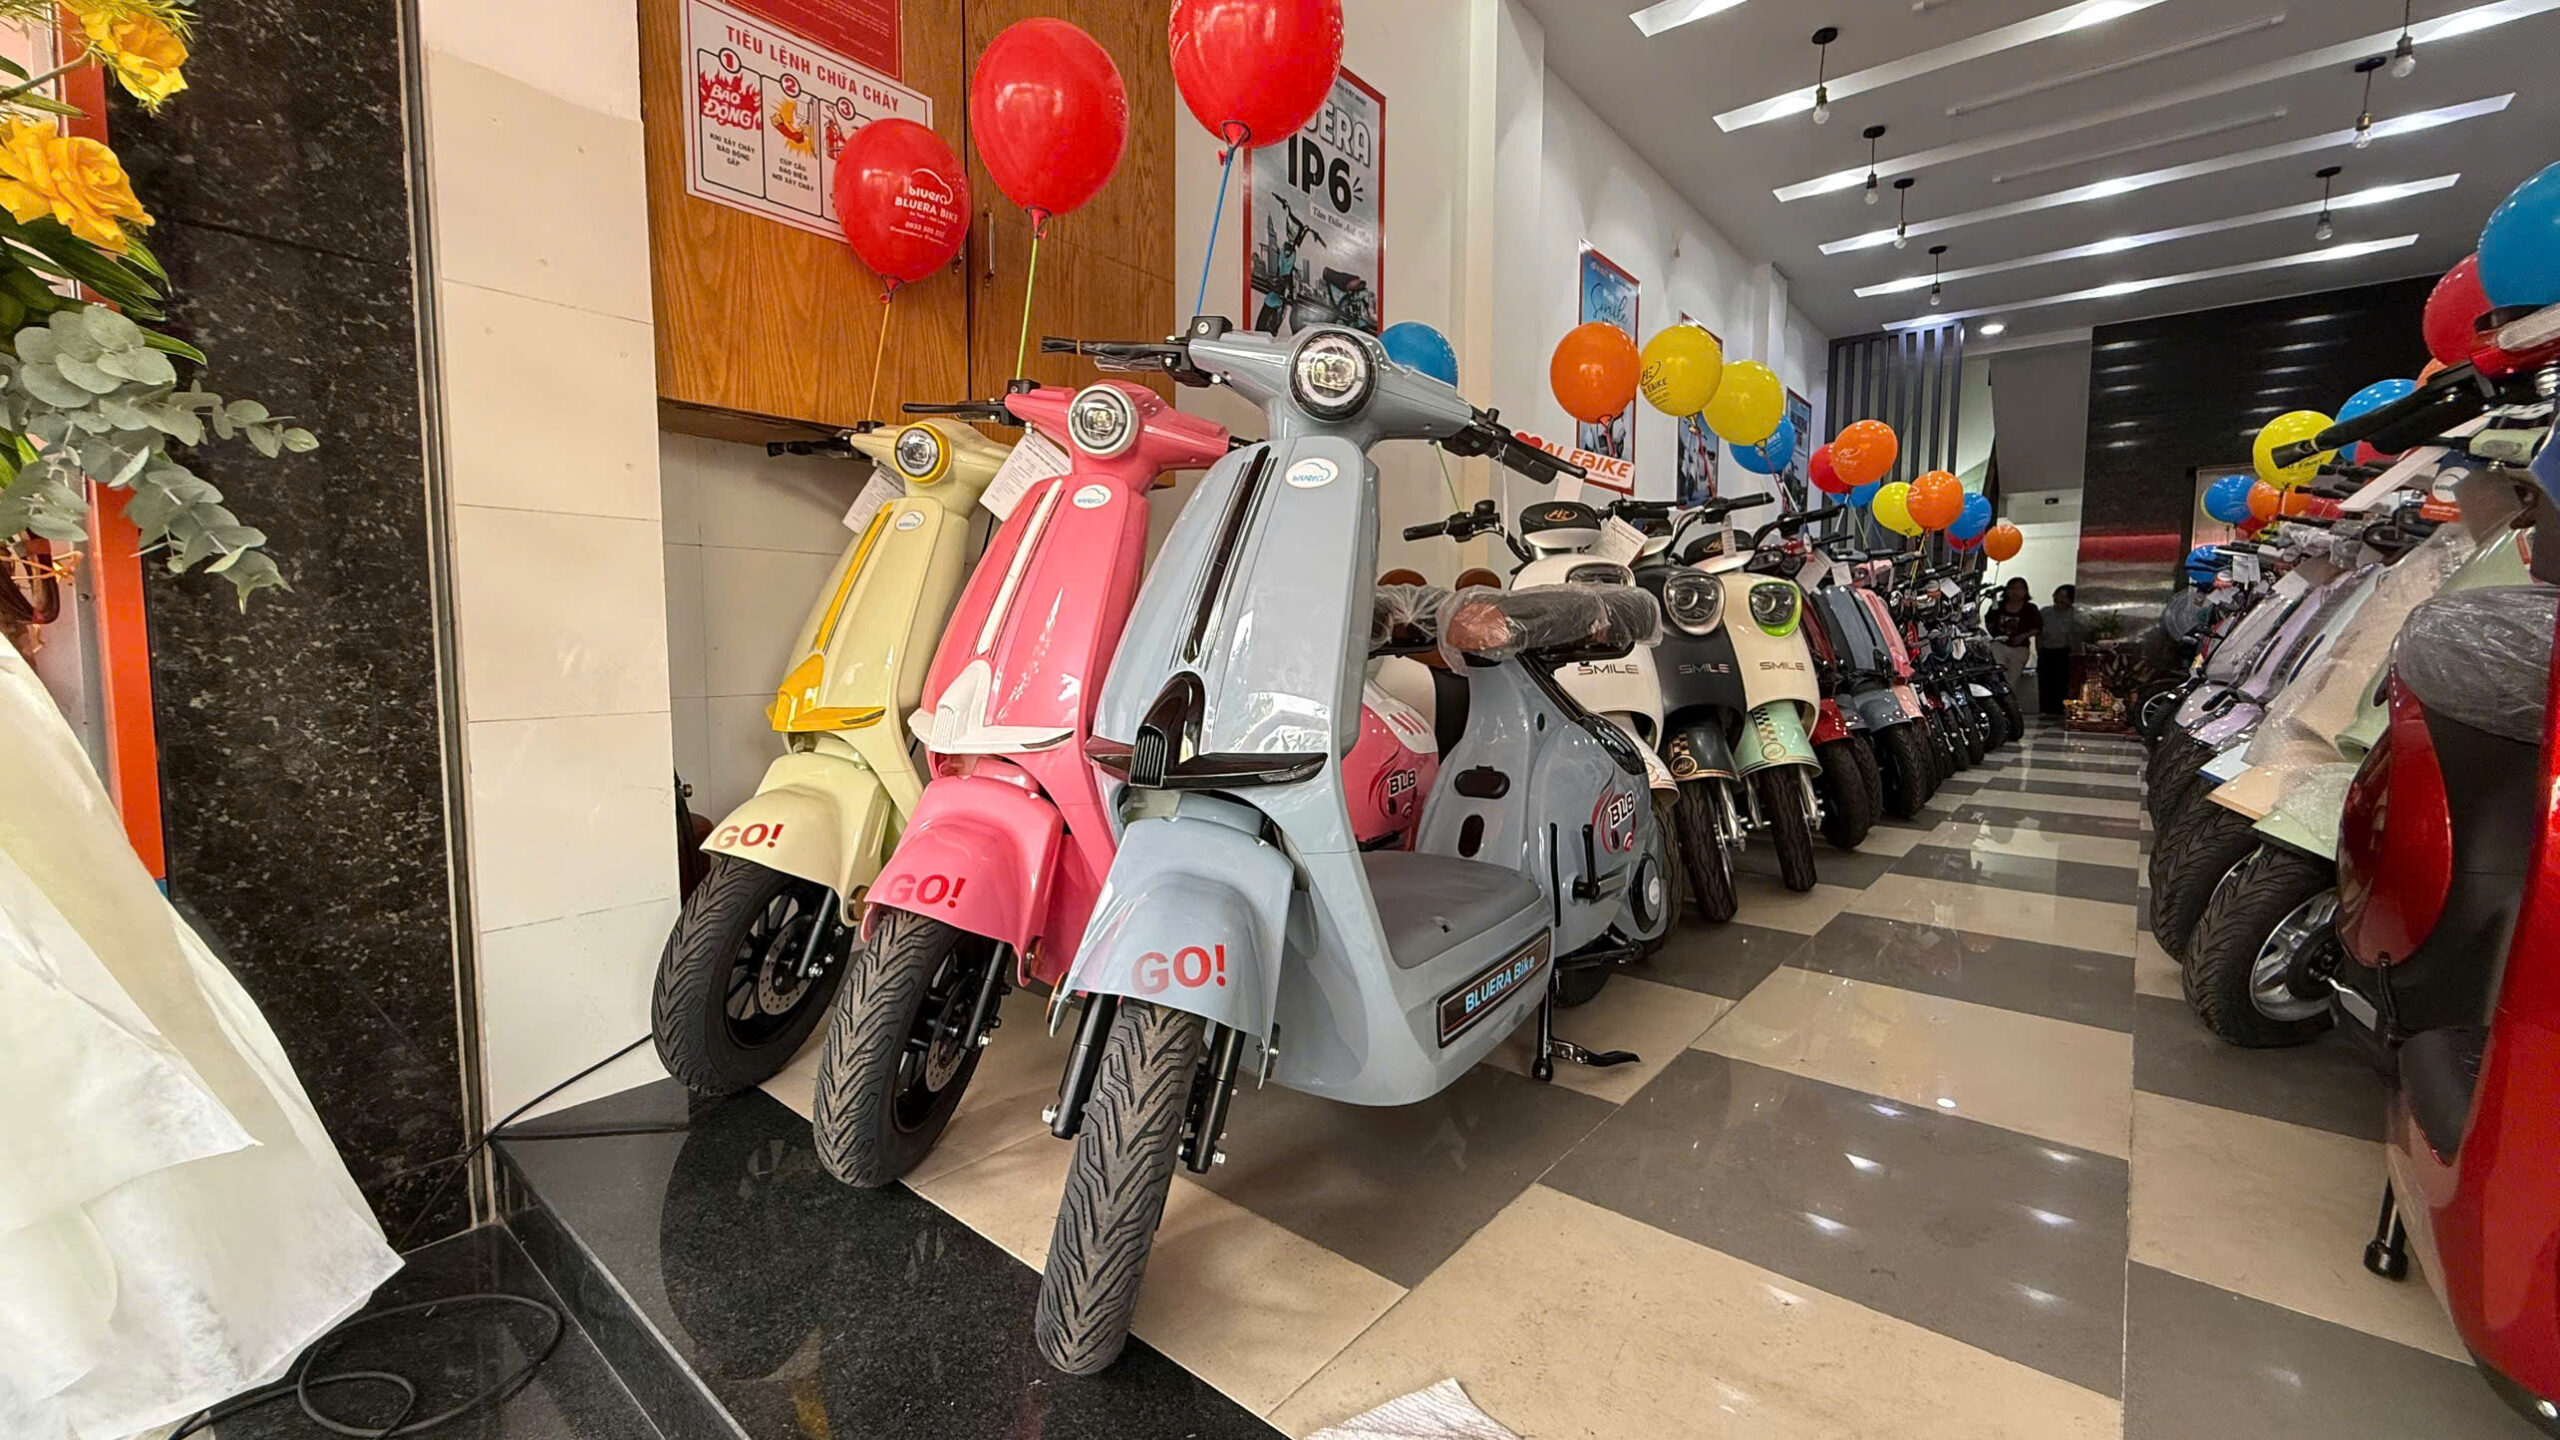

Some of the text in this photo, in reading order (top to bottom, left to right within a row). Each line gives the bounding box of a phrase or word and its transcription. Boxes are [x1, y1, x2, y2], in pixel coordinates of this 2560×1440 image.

[724, 53, 734, 69] 1
[726, 25, 763, 54] TIÊU
[769, 44, 811, 75] LỆNH
[817, 65, 857, 96] CHỮA
[863, 84, 899, 112] CHÁY
[784, 77, 797, 94] 2
[840, 100, 851, 116] 3
[1287, 133, 1352, 213] IP6
[894, 196, 937, 216] BLUERA
[940, 208, 958, 223] BIKE
[1569, 450, 1631, 478] EBIKE
[1578, 663, 1639, 676] SMILE
[1679, 663, 1730, 674] SMILE
[1759, 661, 1806, 671] SMILE
[712, 823, 784, 849] GO!
[886, 874, 967, 908] GO!
[1131, 944, 1227, 995] GO!
[1465, 955, 1535, 1014] BLUERA Bike
